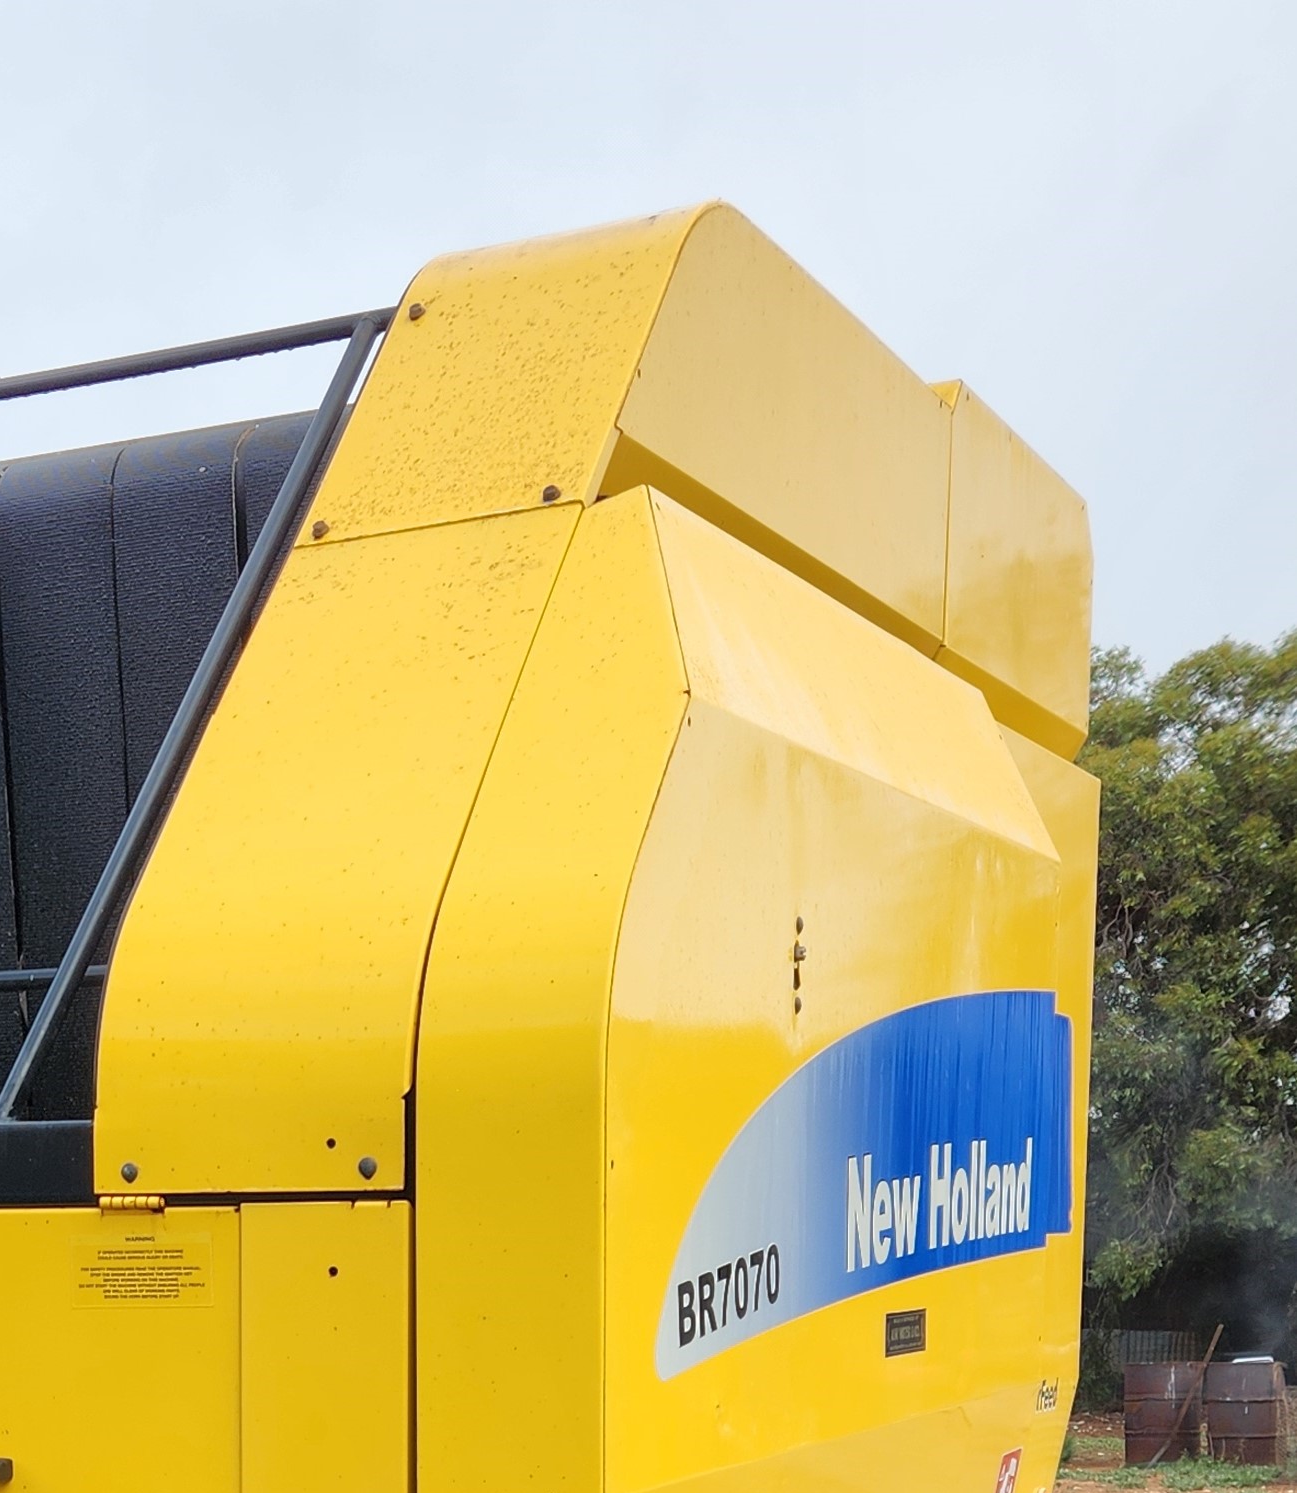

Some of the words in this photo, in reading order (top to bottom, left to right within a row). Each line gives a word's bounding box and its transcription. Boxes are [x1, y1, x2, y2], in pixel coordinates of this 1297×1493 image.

[846, 1152, 921, 1273] New
[928, 1136, 1033, 1249] Holland
[678, 1243, 780, 1348] BR7070
